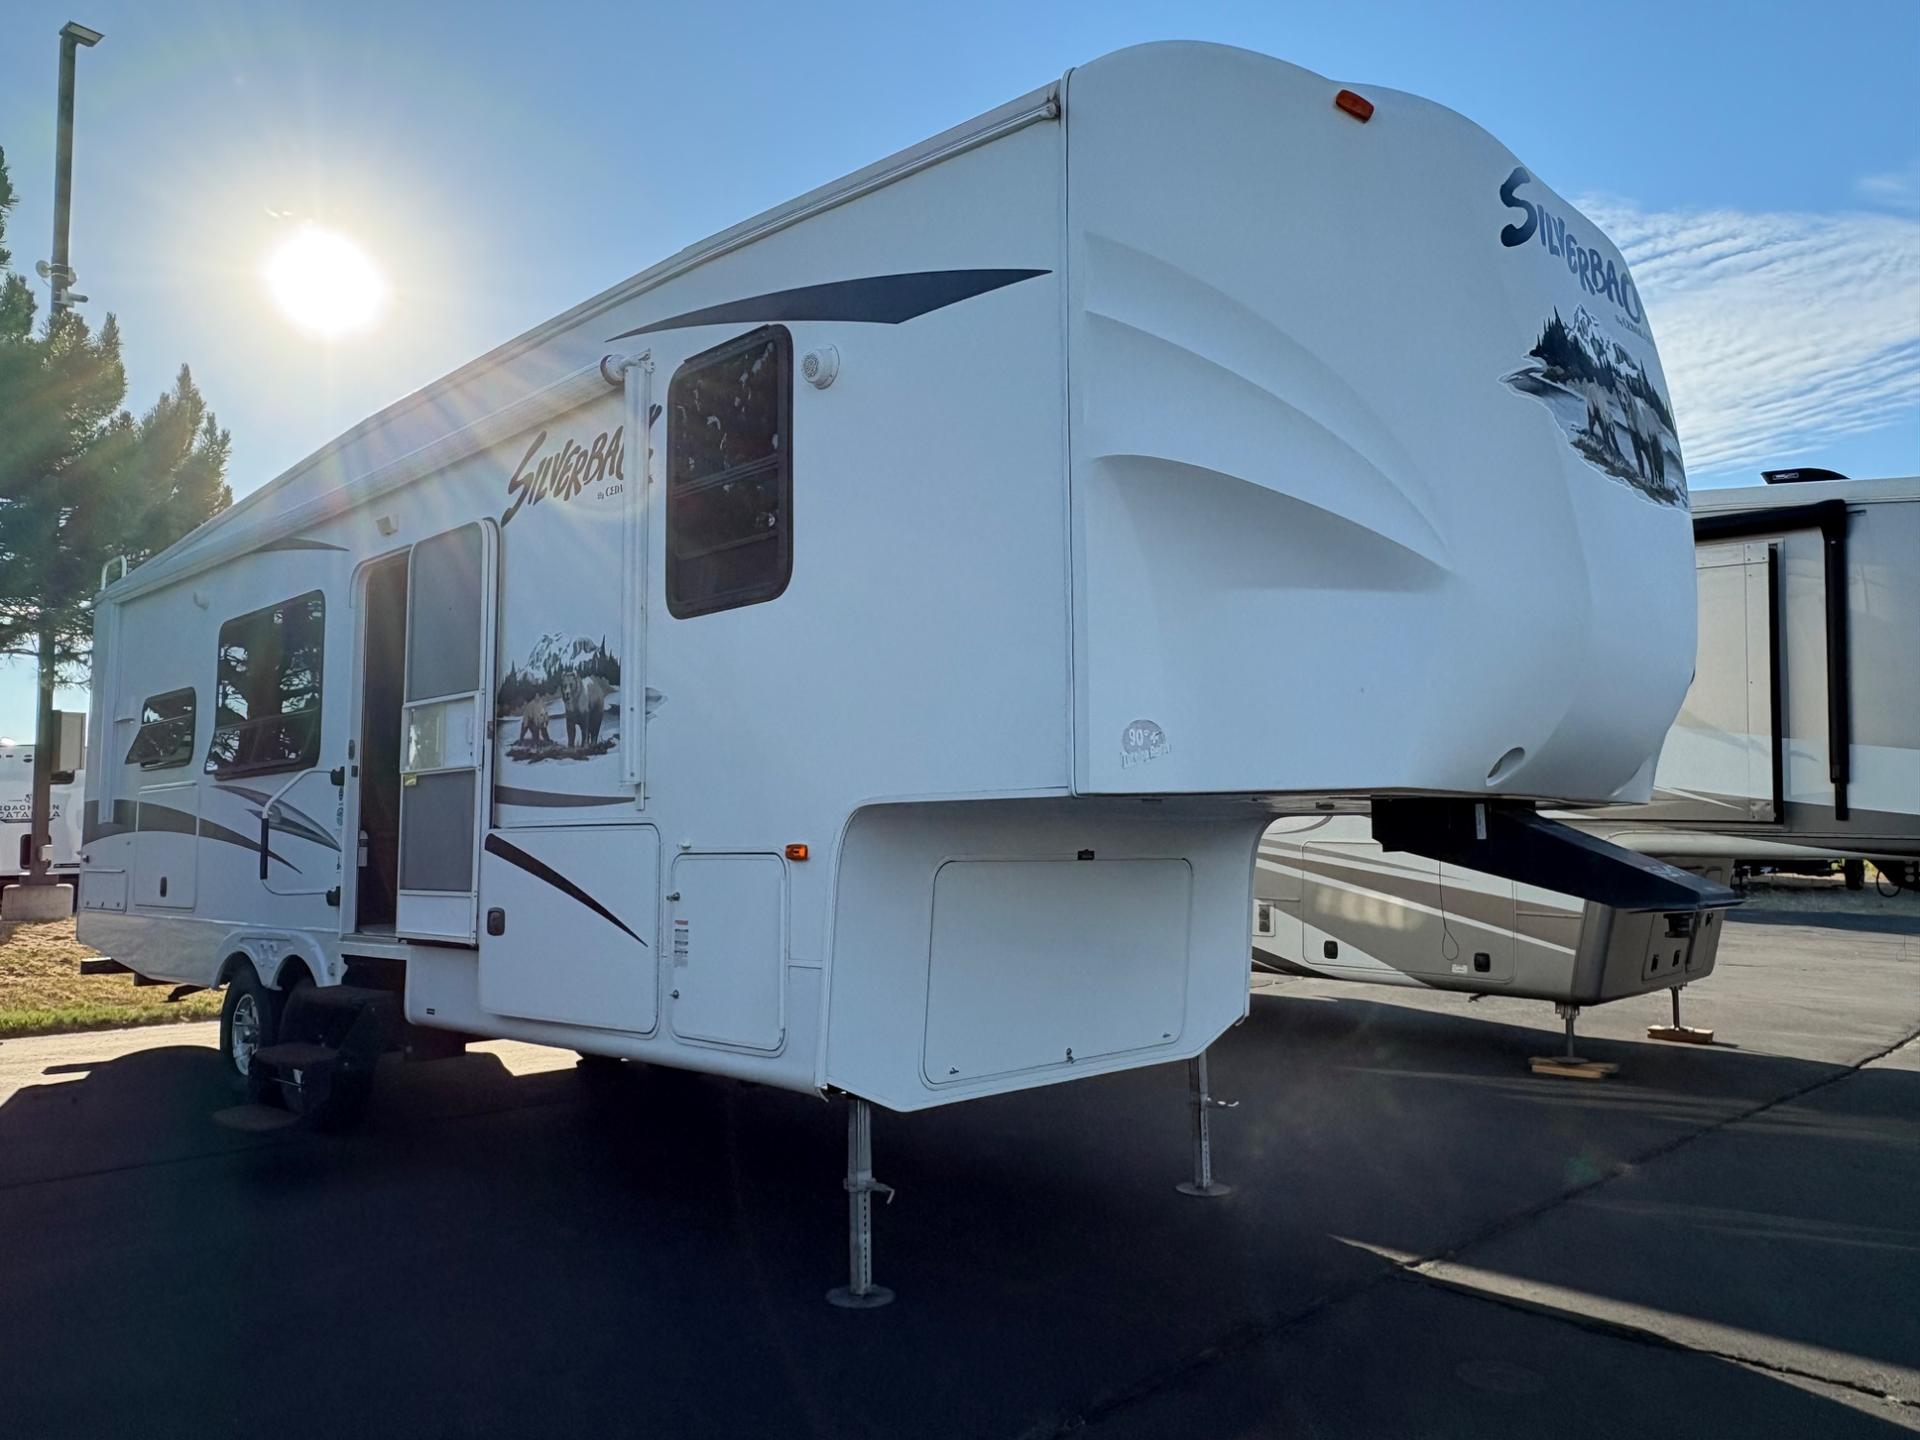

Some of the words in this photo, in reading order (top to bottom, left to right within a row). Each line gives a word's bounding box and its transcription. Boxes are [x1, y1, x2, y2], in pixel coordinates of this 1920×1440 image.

[1500, 166, 1641, 324] SILVERBAC
[501, 404, 662, 528] SILVERBA
[605, 483, 624, 497] CED
